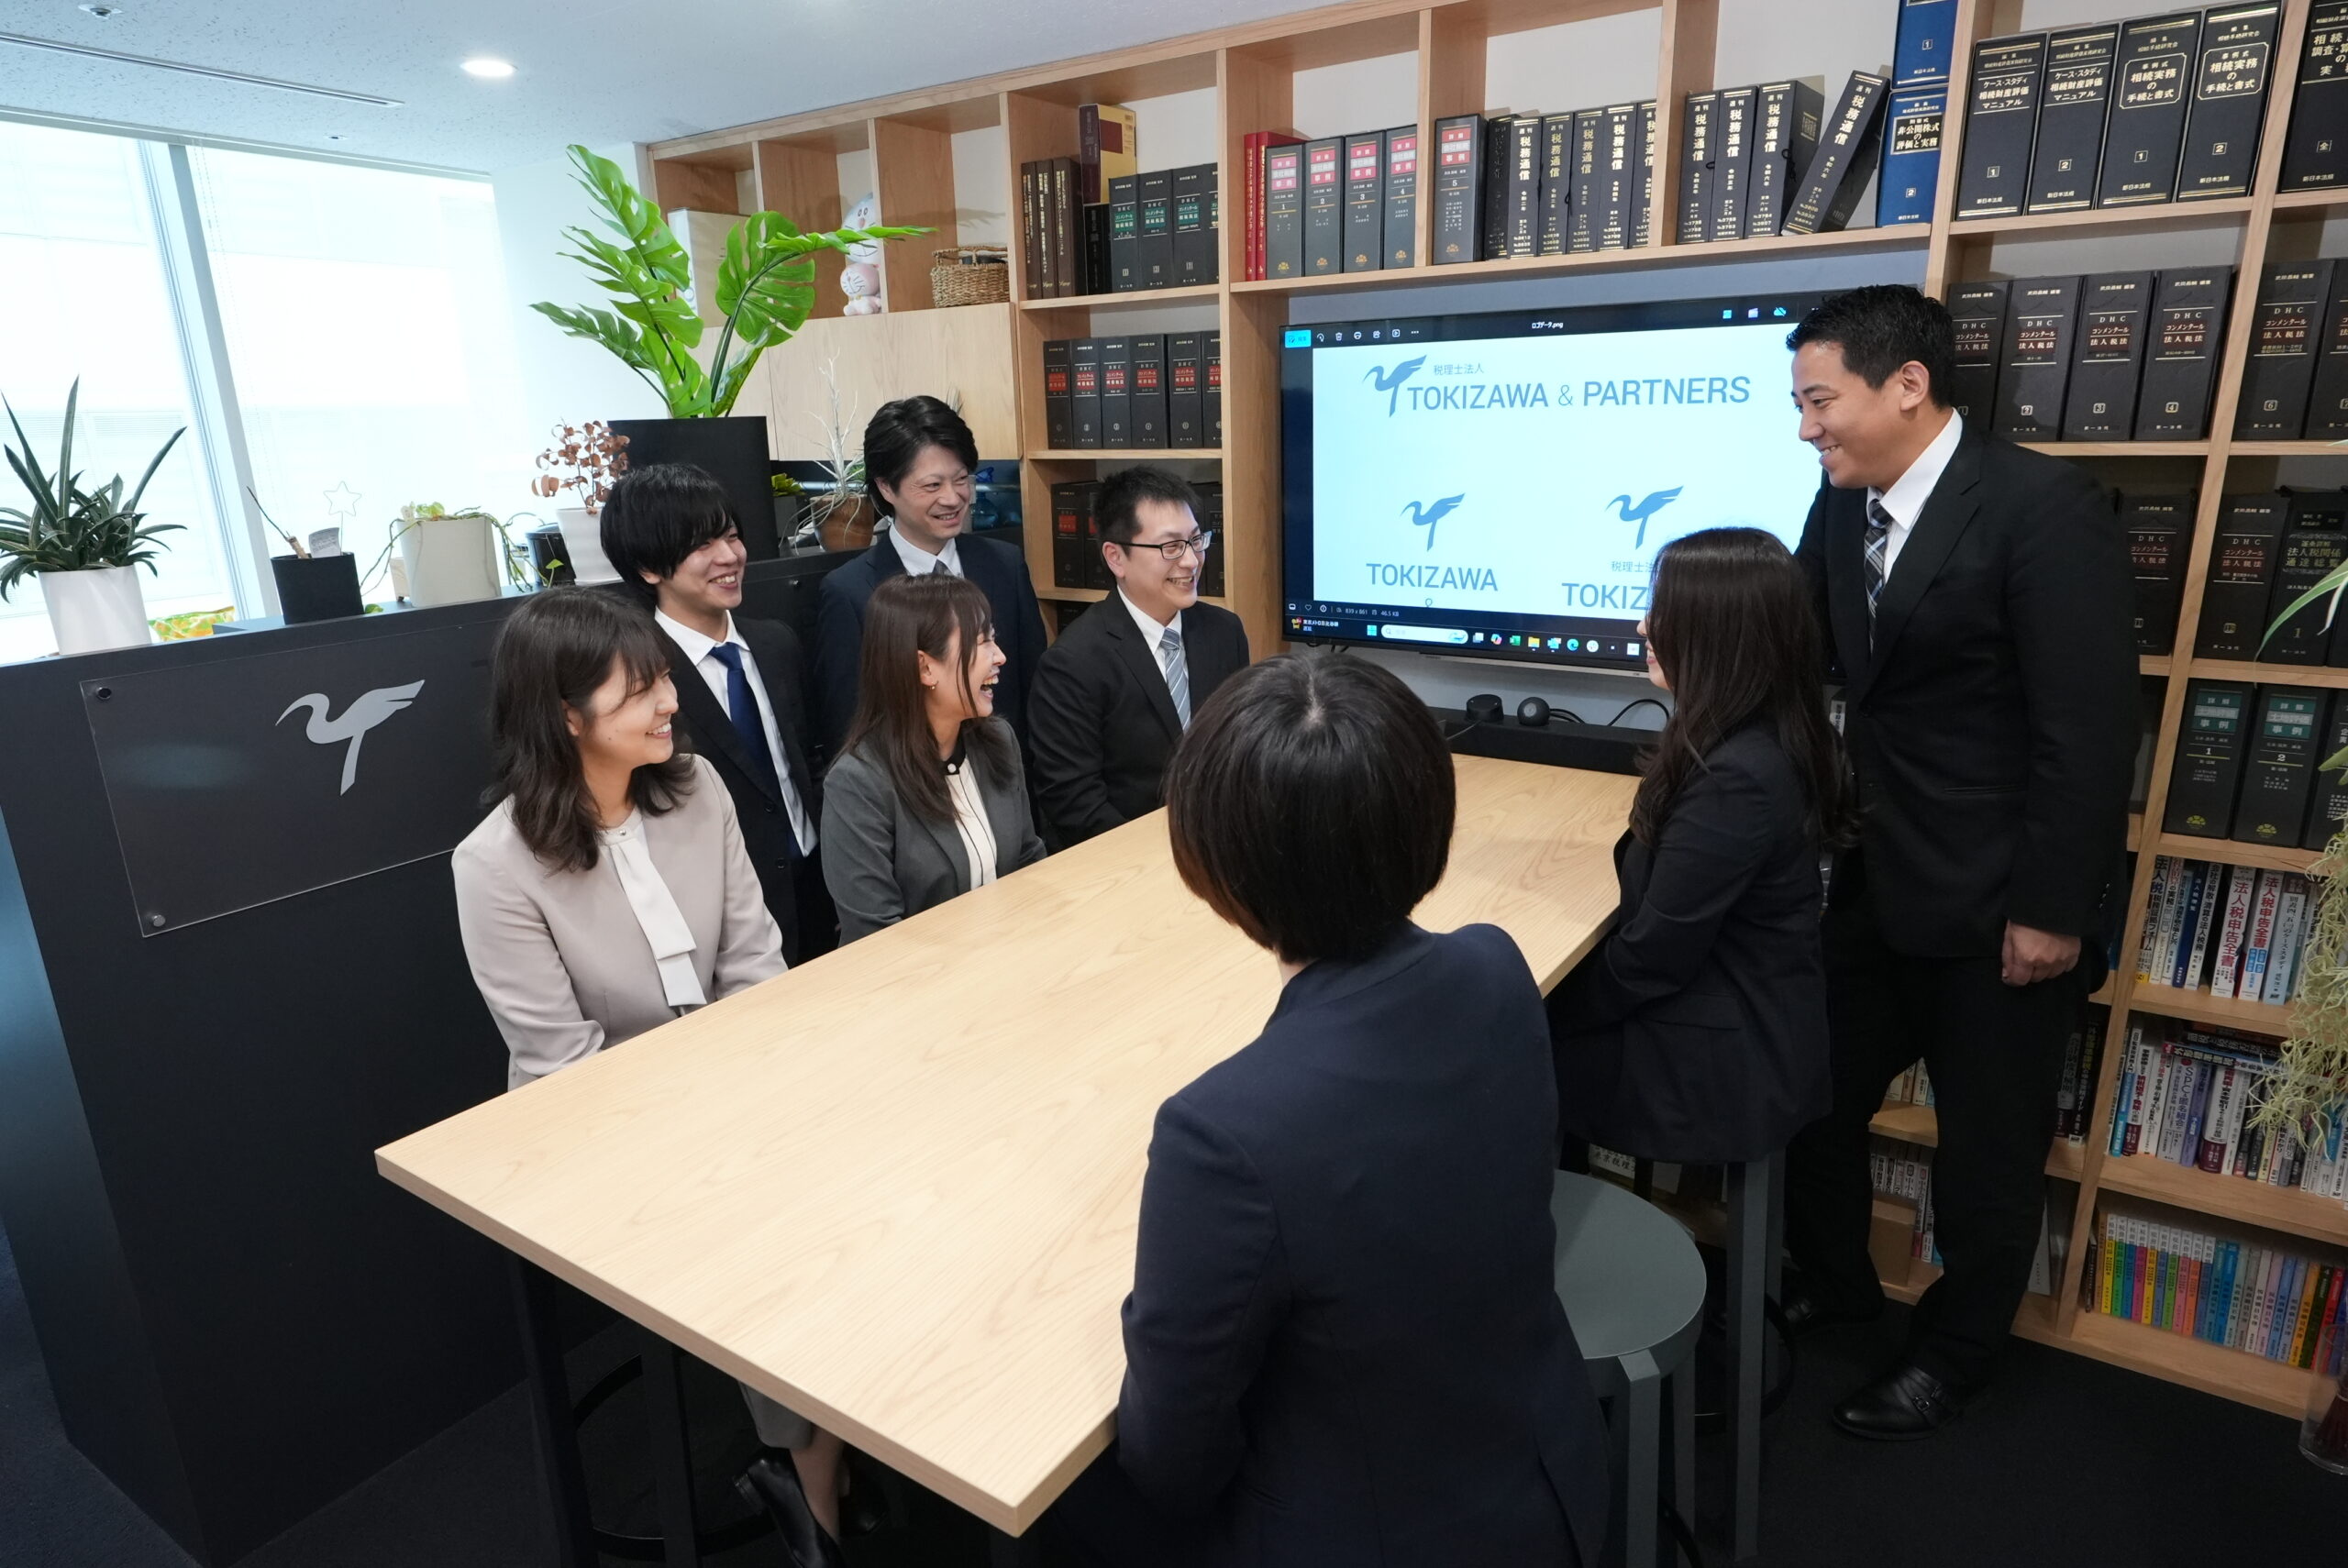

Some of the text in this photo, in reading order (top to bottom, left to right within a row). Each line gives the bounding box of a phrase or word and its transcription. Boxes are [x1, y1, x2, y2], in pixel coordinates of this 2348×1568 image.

[2313, 31, 2348, 46] 相続
[2210, 57, 2258, 73] 相続実務
[2334, 54, 2346, 63] の
[2054, 67, 2102, 80] ケース・スタディ
[2130, 68, 2177, 83] 相続実務
[2226, 72, 2238, 81] の
[1983, 77, 2028, 89] ケース・スタディ
[2050, 77, 2104, 92] 相続財産評価
[2146, 82, 2157, 91] の
[2205, 79, 2256, 94] 手続と書式
[1978, 85, 2030, 100] 相続財産評価
[2054, 90, 2097, 101] マニュアル
[2127, 89, 2175, 104] 手続と書式
[1982, 98, 2023, 109] マニュアル
[1833, 94, 1866, 146] 税務通信
[1726, 108, 1743, 158] 税務通信
[1764, 104, 1781, 153] 税務通信
[1897, 122, 1940, 136] 非公開株式
[1692, 113, 1707, 161] 税務通信
[1913, 132, 1922, 140] の
[1611, 124, 1625, 171] 税務通信
[1896, 137, 1938, 150] 評価と実務
[1549, 133, 1562, 178] 税務通信
[1580, 128, 1594, 175] 税務通信
[1519, 136, 1532, 182] 税務通信
[1452, 179, 1458, 187] 5
[1281, 203, 1286, 211] 1
[2164, 335, 2203, 344] 法人税法
[2263, 330, 2305, 339] 法人税法
[2090, 337, 2128, 347] 法人税法
[1433, 362, 1485, 377] 税理士法人
[1406, 376, 1751, 412] TOKIZAWA & PARTNERS
[2287, 547, 2342, 558] 法人税関係
[1611, 560, 1655, 574] 税理士法
[1366, 563, 1499, 592] TOKIZAWA
[1561, 582, 1651, 611] TOKIZ
[2199, 718, 2230, 730] 事例
[2272, 724, 2303, 736] 事例
[2205, 747, 2212, 756] 1
[2276, 754, 2287, 762] 2
[2253, 877, 2280, 949] 法人税申告全書
[2221, 881, 2249, 968] 法人税申告全書
